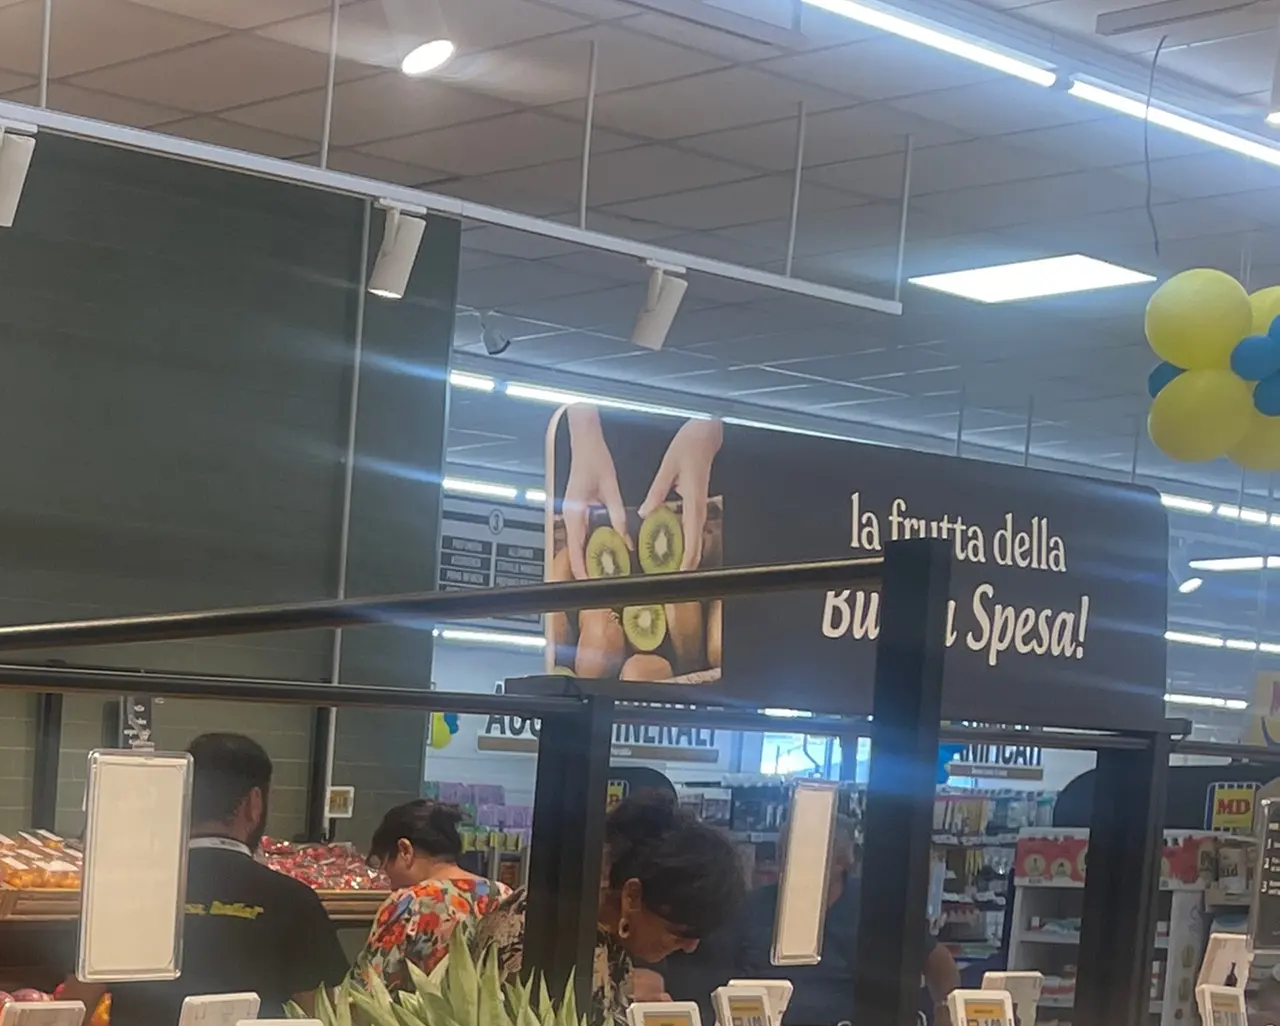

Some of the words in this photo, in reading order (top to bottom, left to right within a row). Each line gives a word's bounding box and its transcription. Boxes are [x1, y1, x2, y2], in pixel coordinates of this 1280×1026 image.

[850, 492, 882, 551] la
[993, 512, 1067, 573] della
[966, 583, 1089, 666] Spesa!
[1216, 799, 1251, 815] MD
